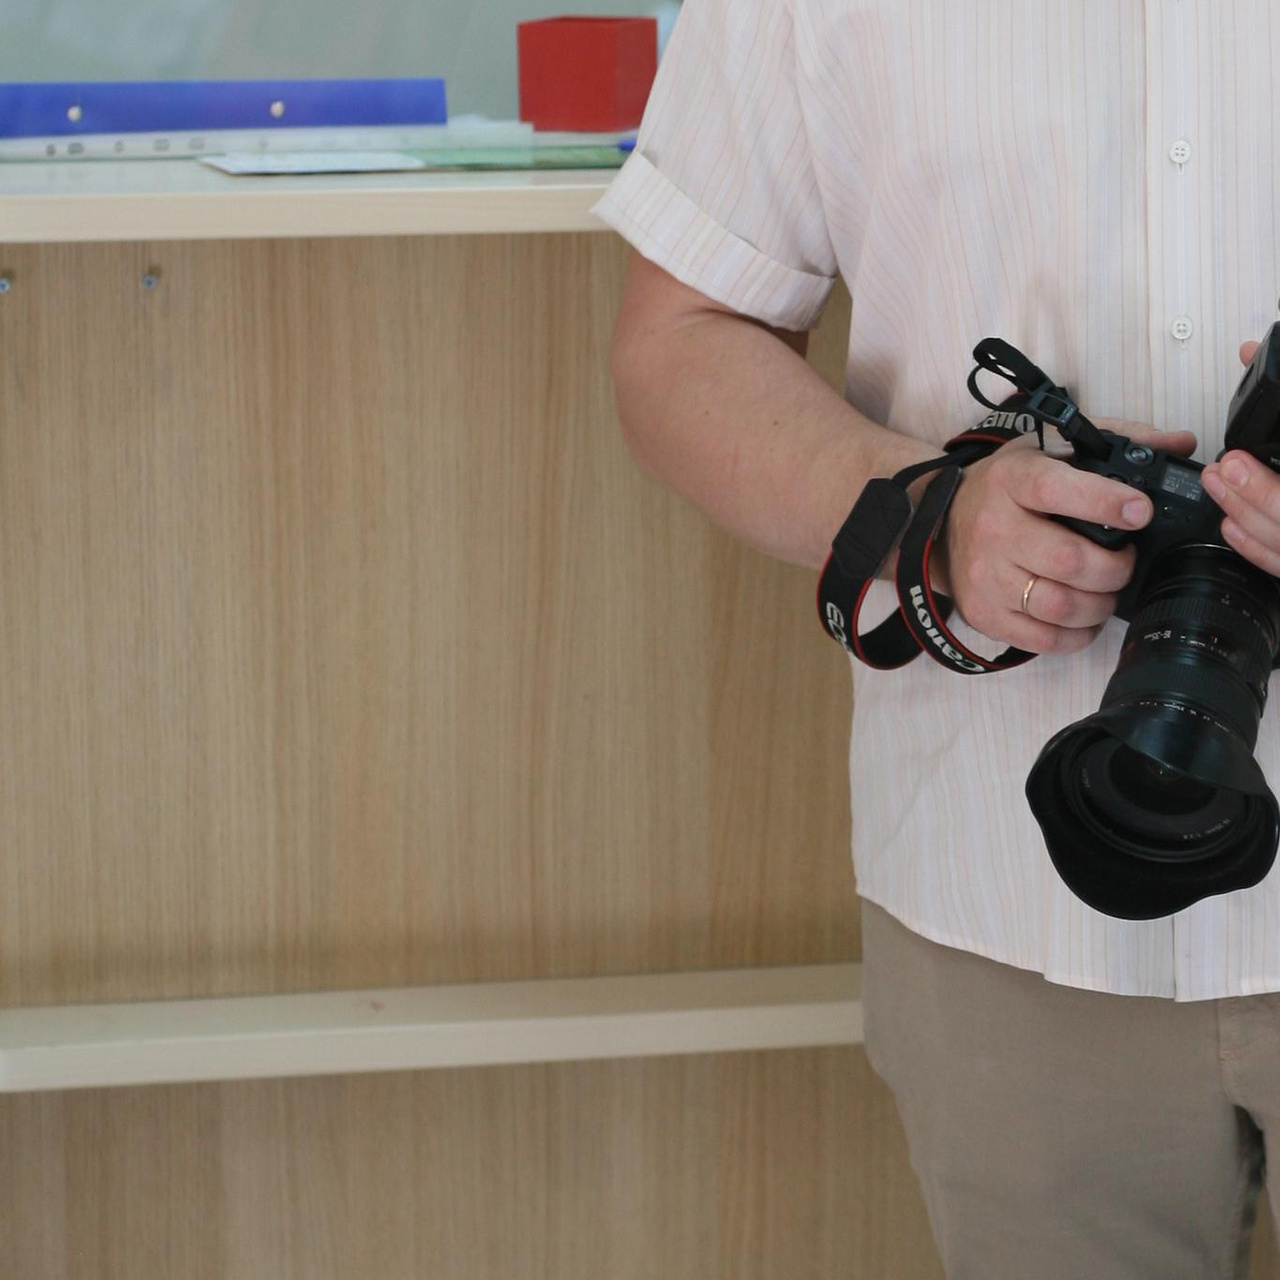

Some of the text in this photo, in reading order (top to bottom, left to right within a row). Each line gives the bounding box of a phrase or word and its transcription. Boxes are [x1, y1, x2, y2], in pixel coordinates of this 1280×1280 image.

[971, 411, 1036, 434] ano
[826, 602, 848, 644] EO
[908, 585, 986, 673] Canon
